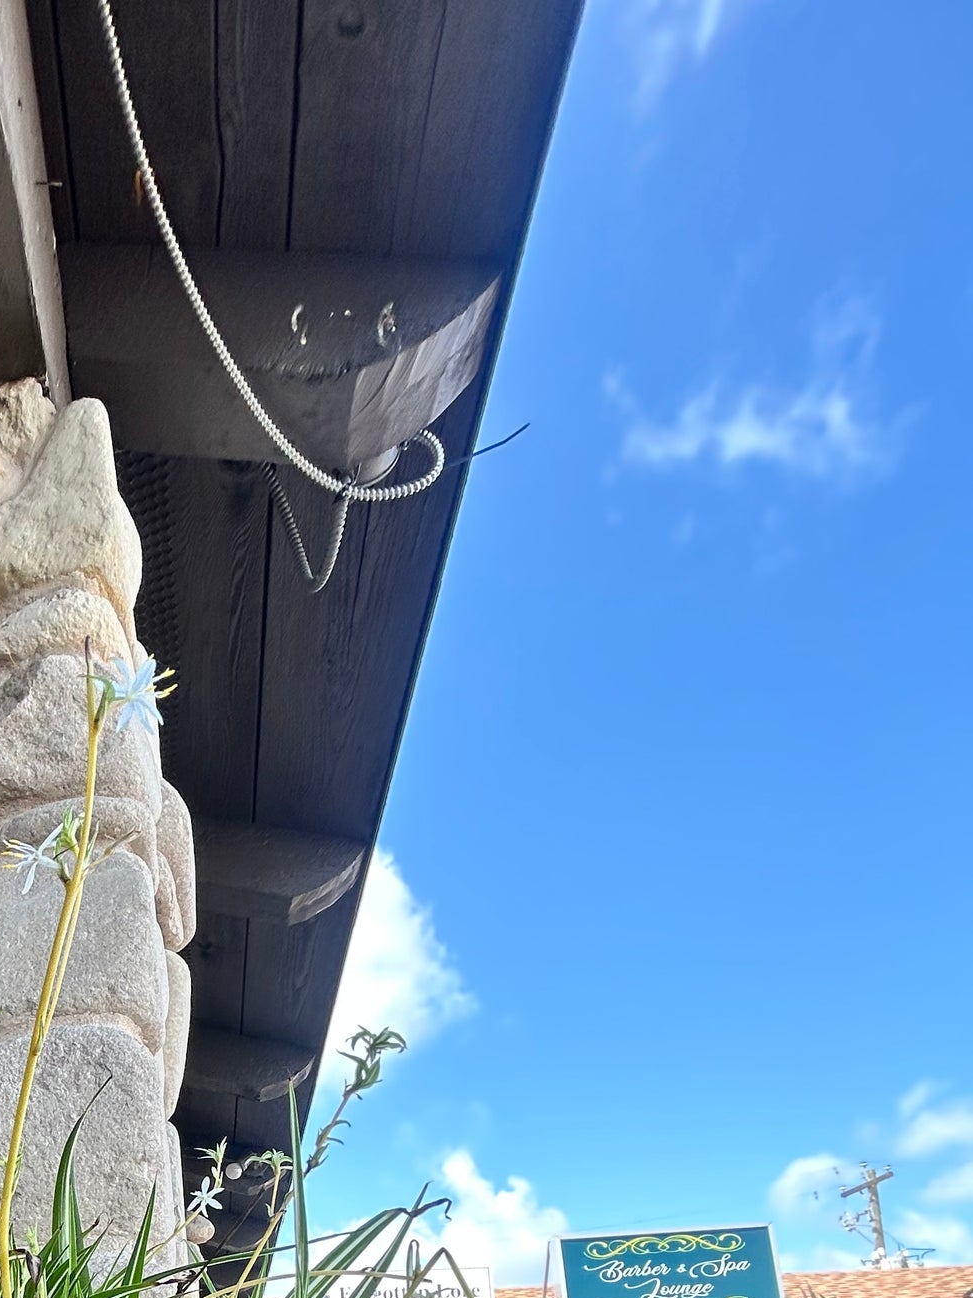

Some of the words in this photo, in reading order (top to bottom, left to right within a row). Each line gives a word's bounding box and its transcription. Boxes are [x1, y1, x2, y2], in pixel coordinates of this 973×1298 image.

[583, 1259, 671, 1283] Barber
[677, 1264, 687, 1273] &
[689, 1253, 751, 1278] Spa
